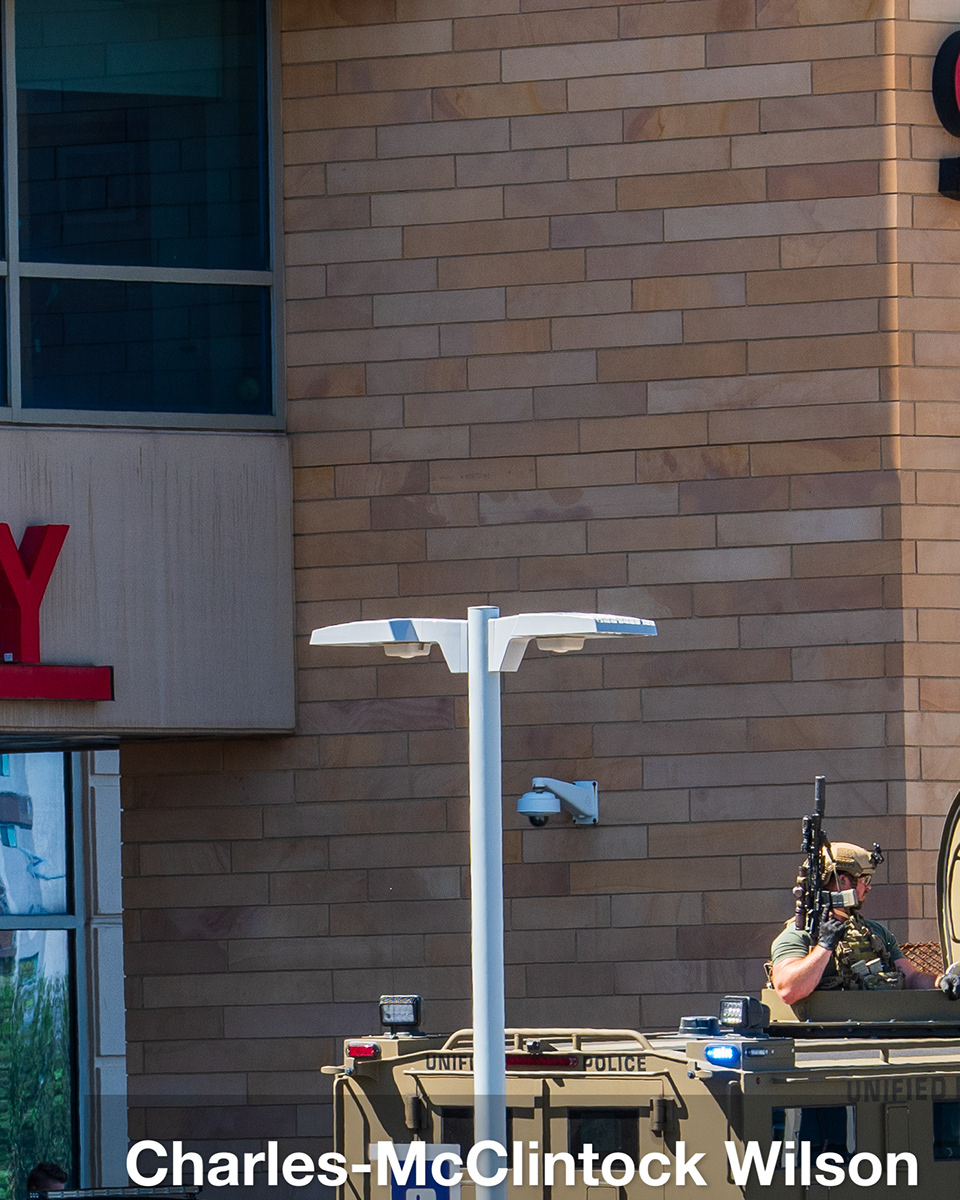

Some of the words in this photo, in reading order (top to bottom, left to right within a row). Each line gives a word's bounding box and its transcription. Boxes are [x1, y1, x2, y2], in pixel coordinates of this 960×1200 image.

[425, 1054, 474, 1071] UNIFI
[585, 1055, 647, 1072] POLICE
[846, 1077, 946, 1102] UNIFIED
